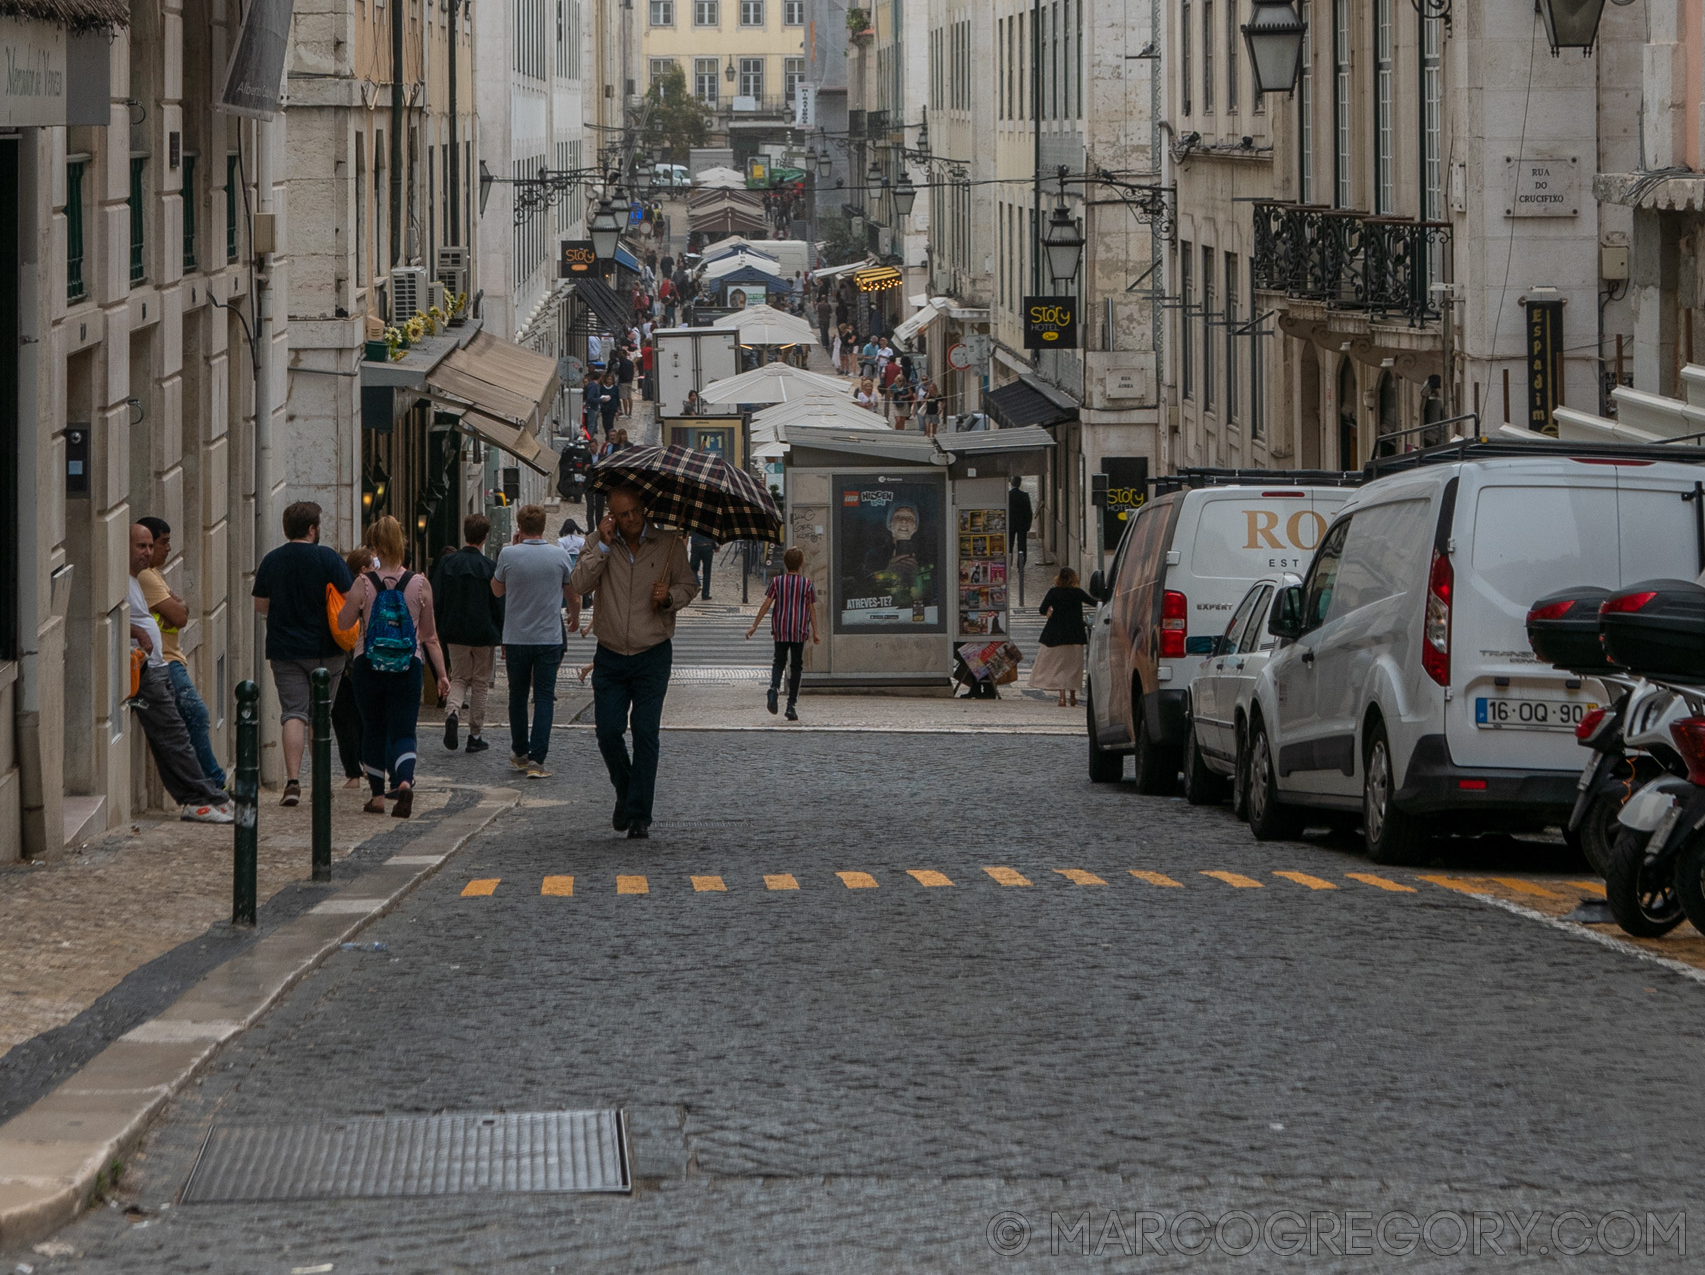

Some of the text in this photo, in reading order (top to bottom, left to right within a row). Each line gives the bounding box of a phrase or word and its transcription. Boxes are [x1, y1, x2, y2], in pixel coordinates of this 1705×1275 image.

[1531, 168, 1551, 177] RUA
[1535, 181, 1548, 190] DO
[1519, 194, 1564, 203] CRUCIFIXO
[565, 248, 595, 264] Story
[1030, 306, 1071, 327] Story
[1031, 323, 1061, 332] HOTEL
[1532, 309, 1545, 420] Espadim
[1107, 488, 1144, 507] Story
[1242, 510, 1336, 550] RO
[846, 596, 893, 609] ATREVES-TE?
